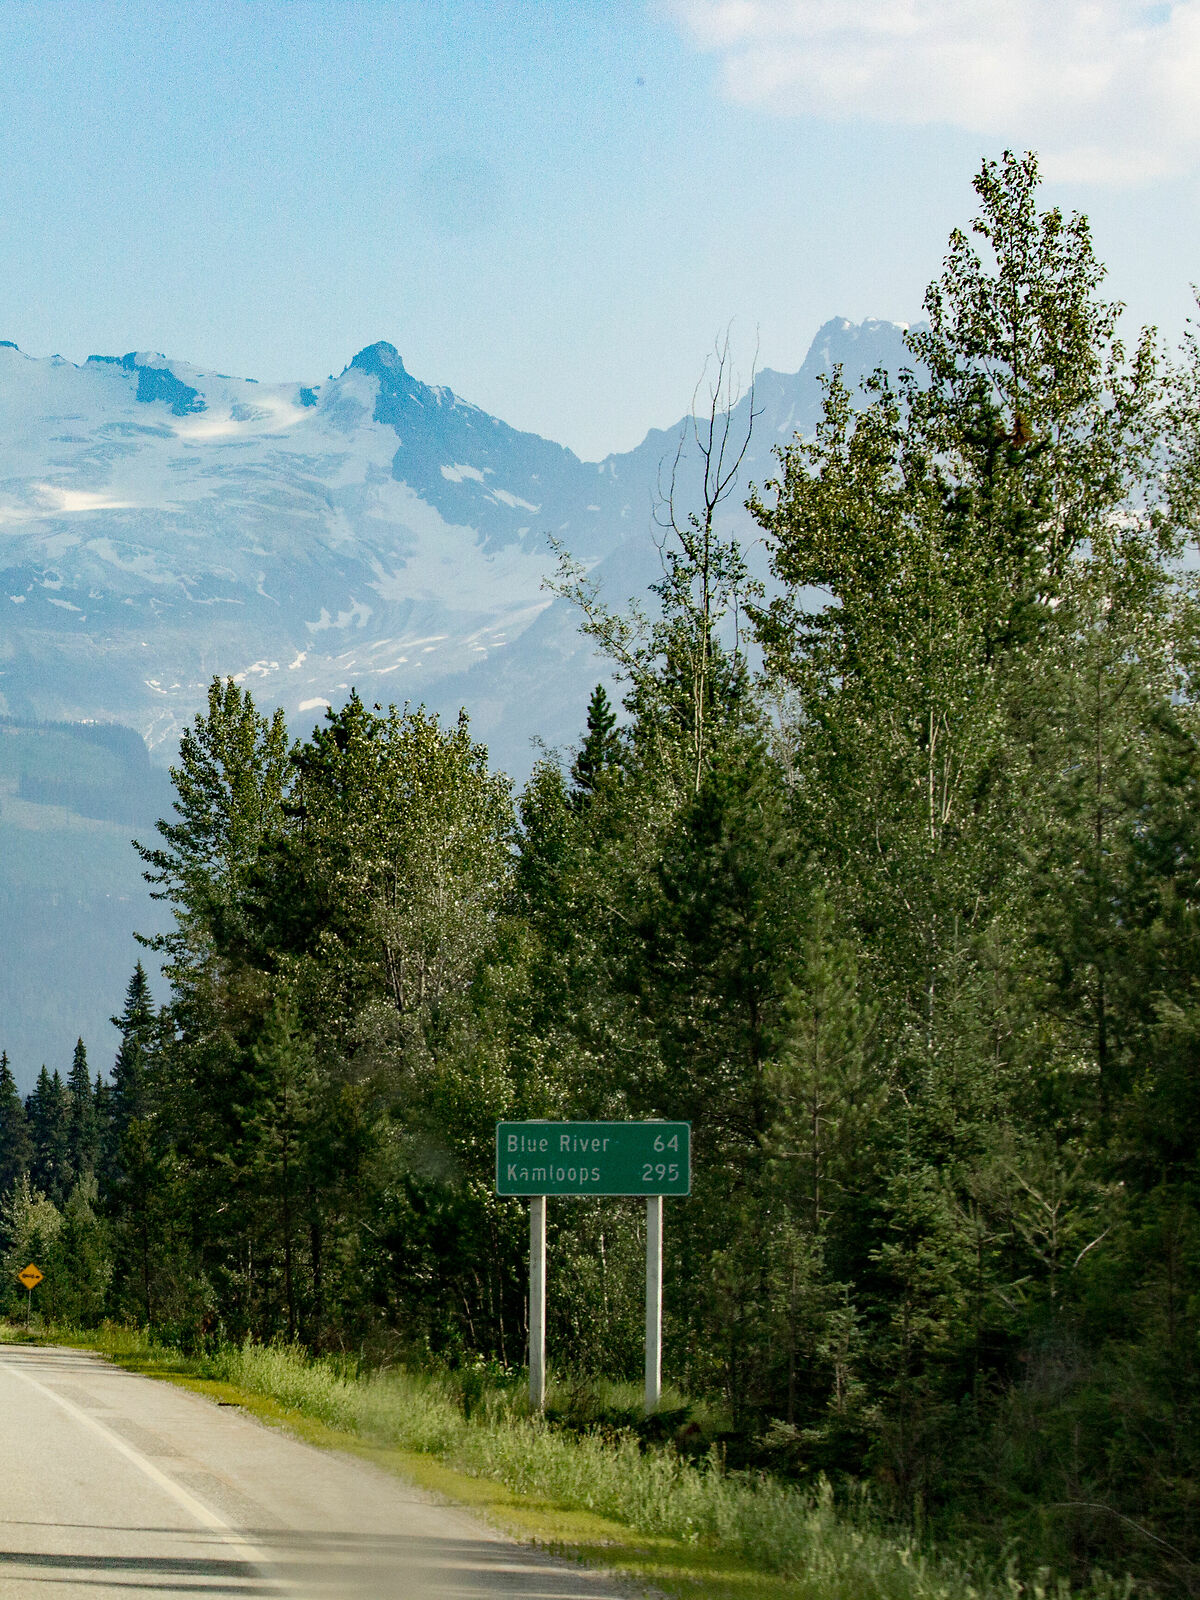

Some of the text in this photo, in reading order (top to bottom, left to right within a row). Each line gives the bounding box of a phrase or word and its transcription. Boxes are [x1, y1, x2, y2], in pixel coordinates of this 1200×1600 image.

[507, 1134, 679, 1152] Blue River 64
[507, 1163, 679, 1185] Kamloops 295
